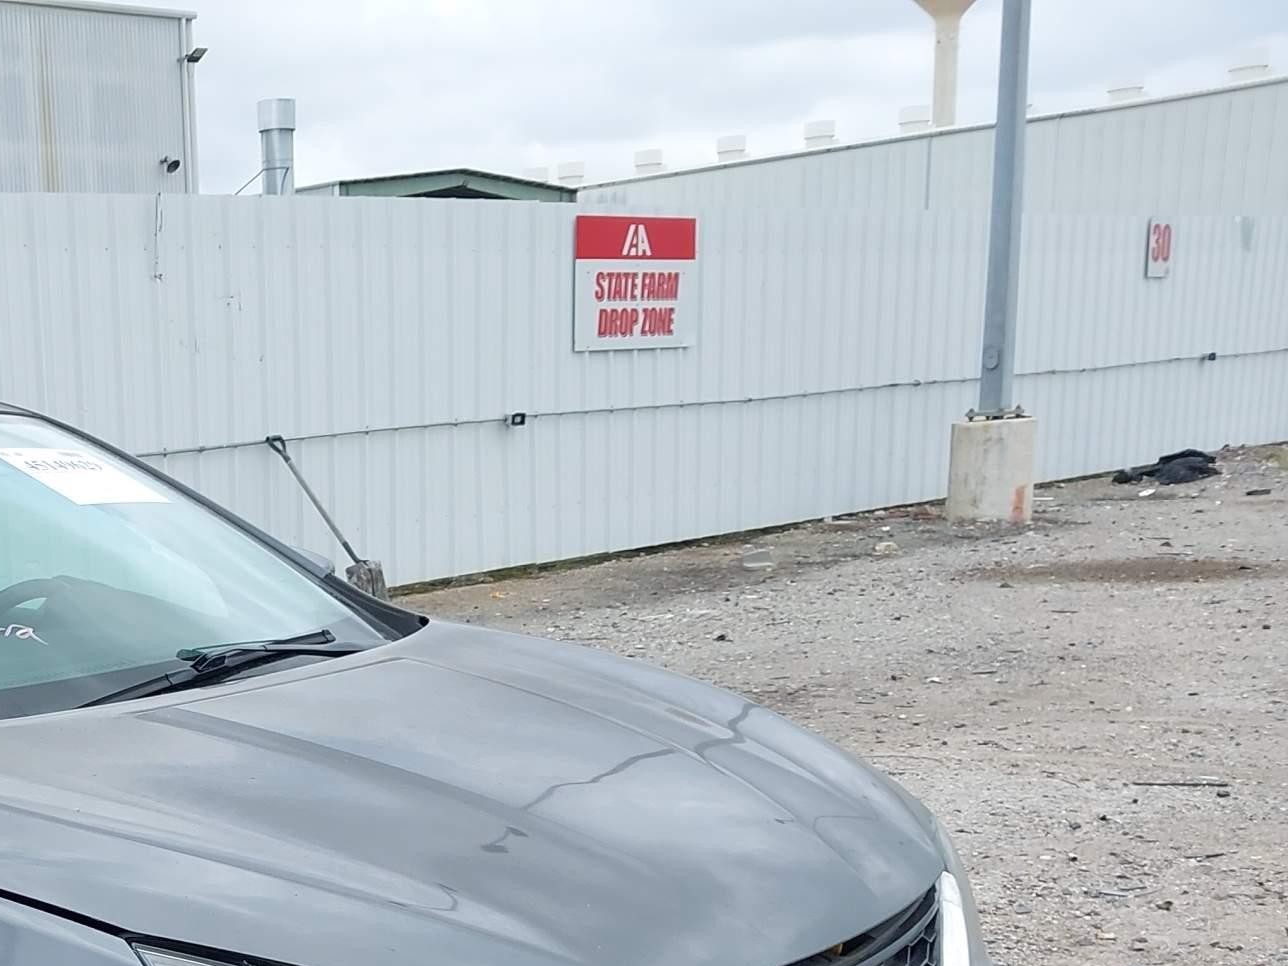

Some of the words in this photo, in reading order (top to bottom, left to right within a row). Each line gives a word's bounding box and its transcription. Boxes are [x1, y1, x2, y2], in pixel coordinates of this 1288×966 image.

[1151, 223, 1172, 262] 30
[595, 271, 639, 302] STATE
[641, 271, 679, 301] FARM
[597, 308, 638, 337] DROP
[641, 307, 675, 336] ZONE
